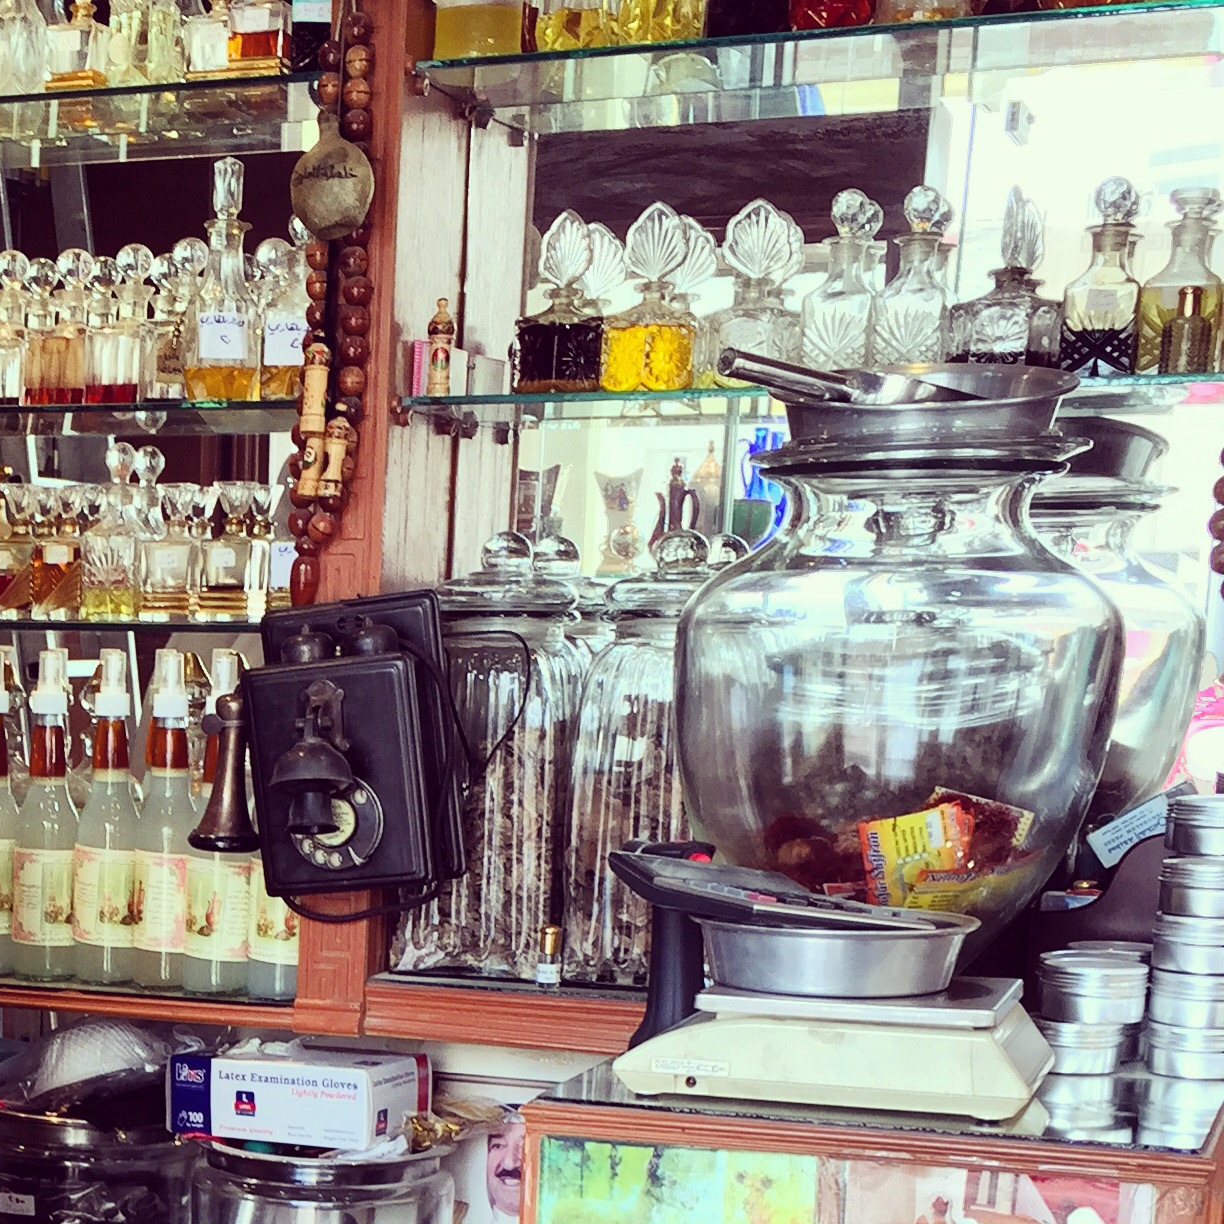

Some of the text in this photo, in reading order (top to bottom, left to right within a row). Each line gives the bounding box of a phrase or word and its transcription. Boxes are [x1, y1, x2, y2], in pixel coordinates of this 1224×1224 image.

[218, 1070, 358, 1091] Latex Examination Gloves
[291, 1087, 357, 1101] Lightly Powdered
[188, 1111, 204, 1123] 100
